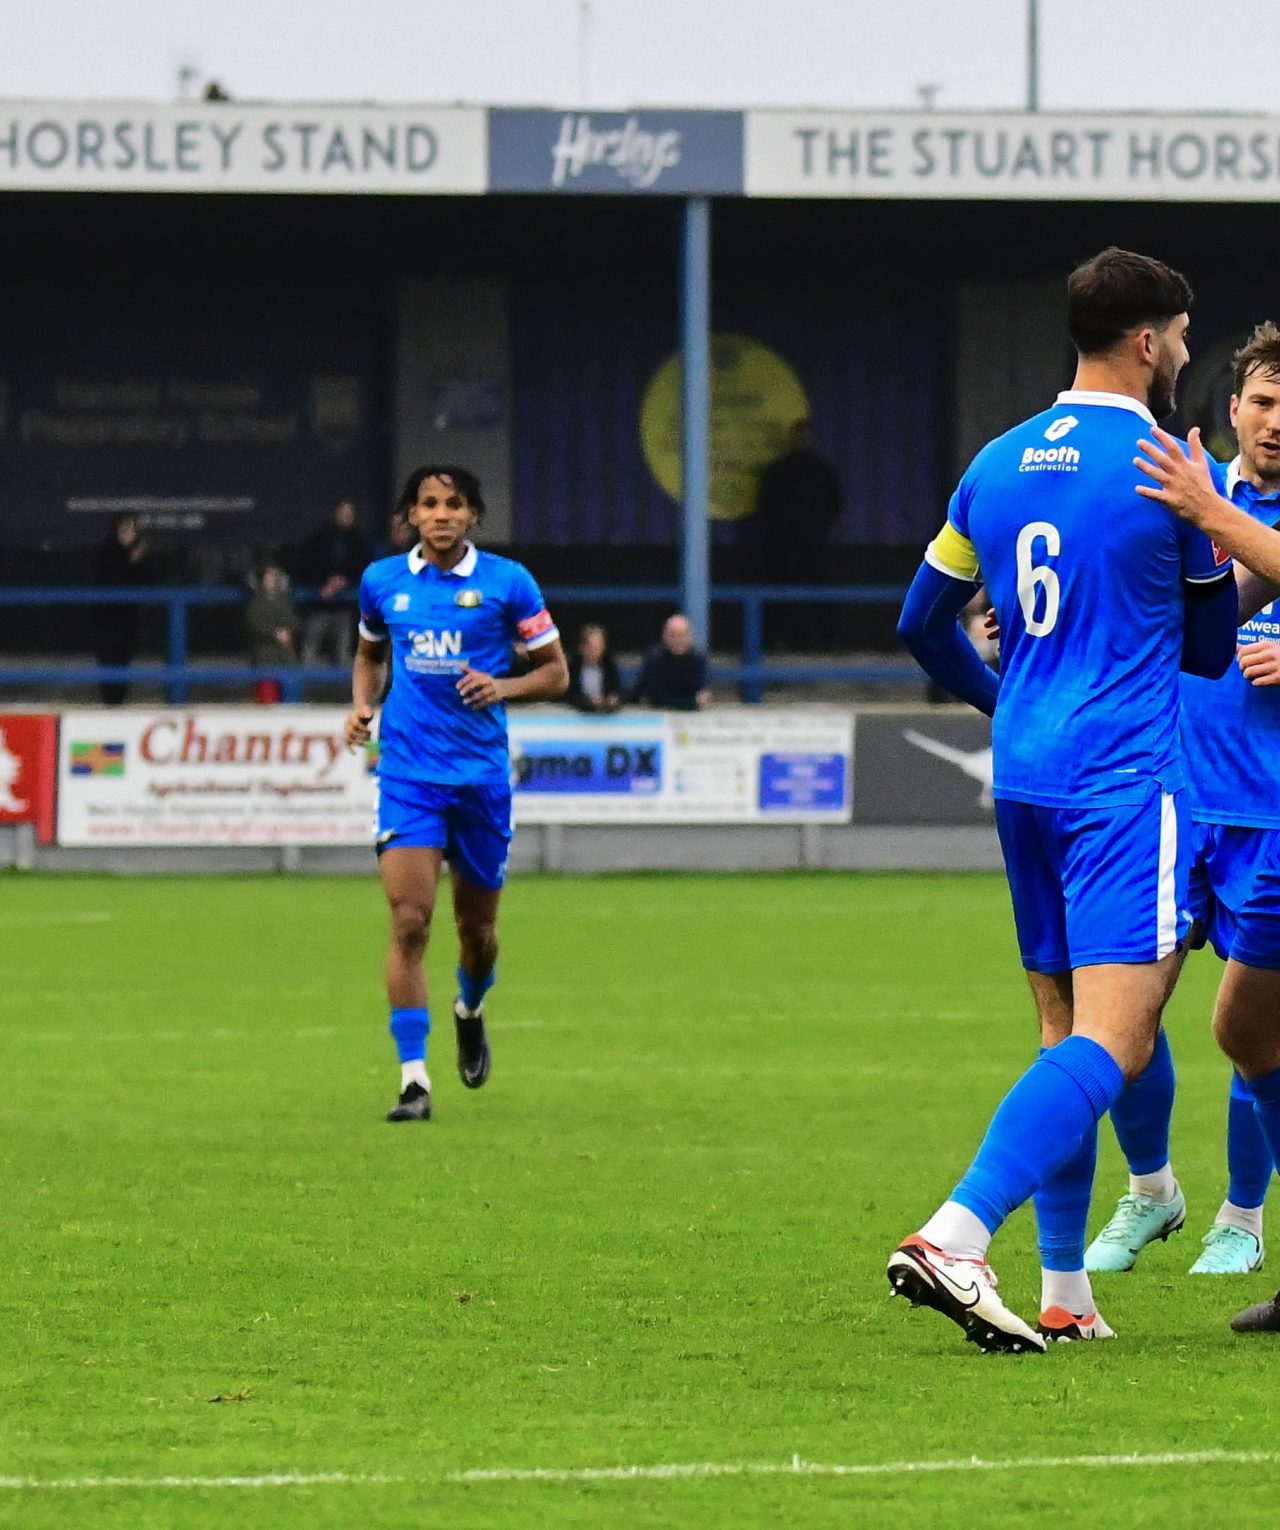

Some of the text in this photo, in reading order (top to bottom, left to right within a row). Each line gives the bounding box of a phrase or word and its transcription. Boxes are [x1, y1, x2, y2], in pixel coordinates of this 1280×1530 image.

[0, 120, 440, 174] HORSLEY STAND
[797, 127, 893, 178] THE
[912, 128, 1109, 180] STUART
[1018, 463, 1079, 473] Construction
[1021, 446, 1081, 464] Booth
[1016, 521, 1061, 638] 6
[138, 714, 345, 779] Chantry
[606, 744, 658, 780] DX
